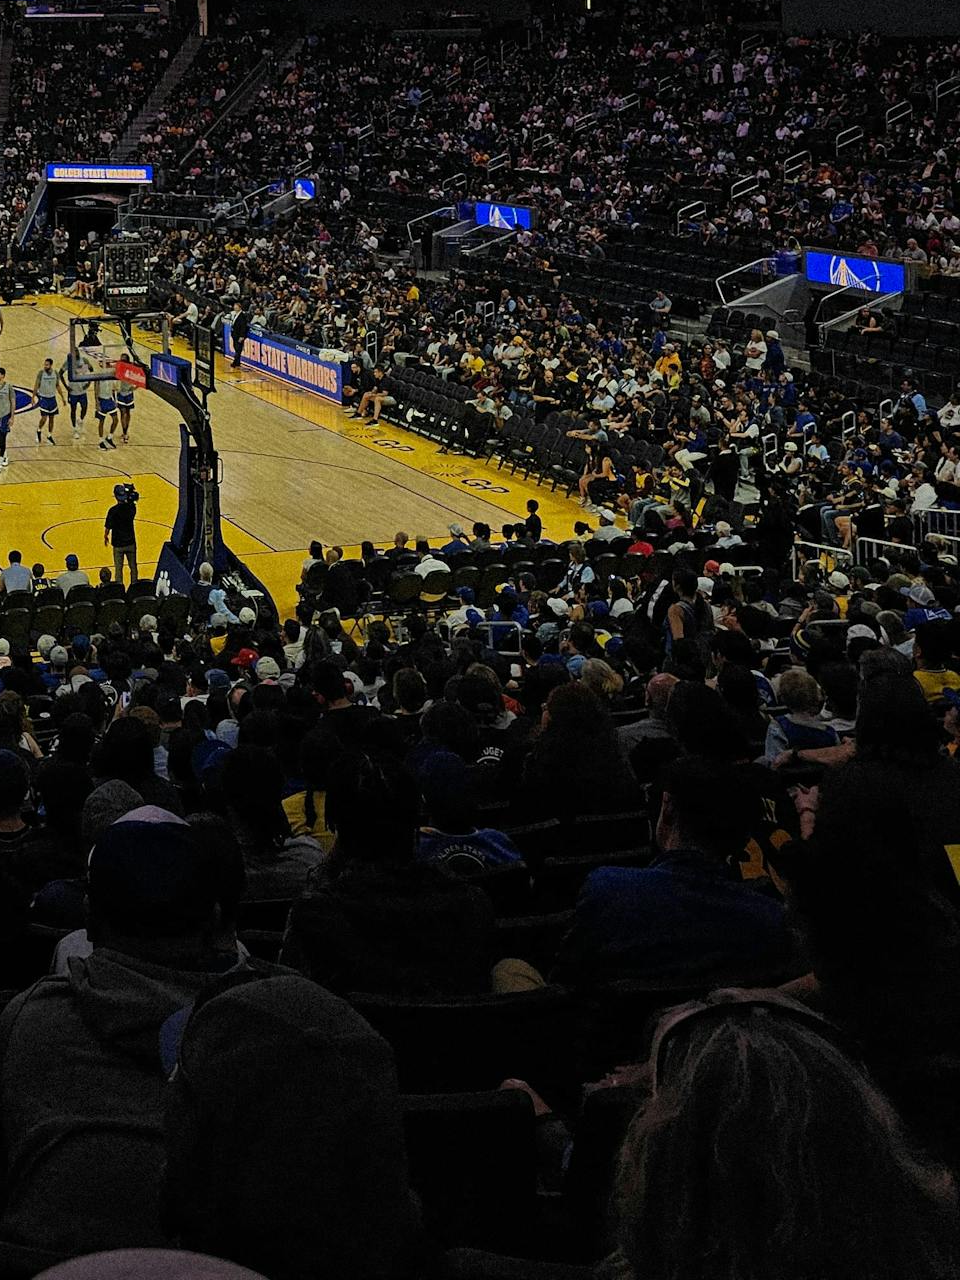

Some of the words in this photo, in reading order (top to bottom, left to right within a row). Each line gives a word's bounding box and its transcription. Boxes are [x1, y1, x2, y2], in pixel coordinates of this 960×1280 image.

[119, 286, 149, 294] TISSOT
[260, 342, 288, 374] STATE
[286, 352, 338, 394] WARRIORS
[373, 439, 415, 452] GP
[461, 478, 510, 494] GP
